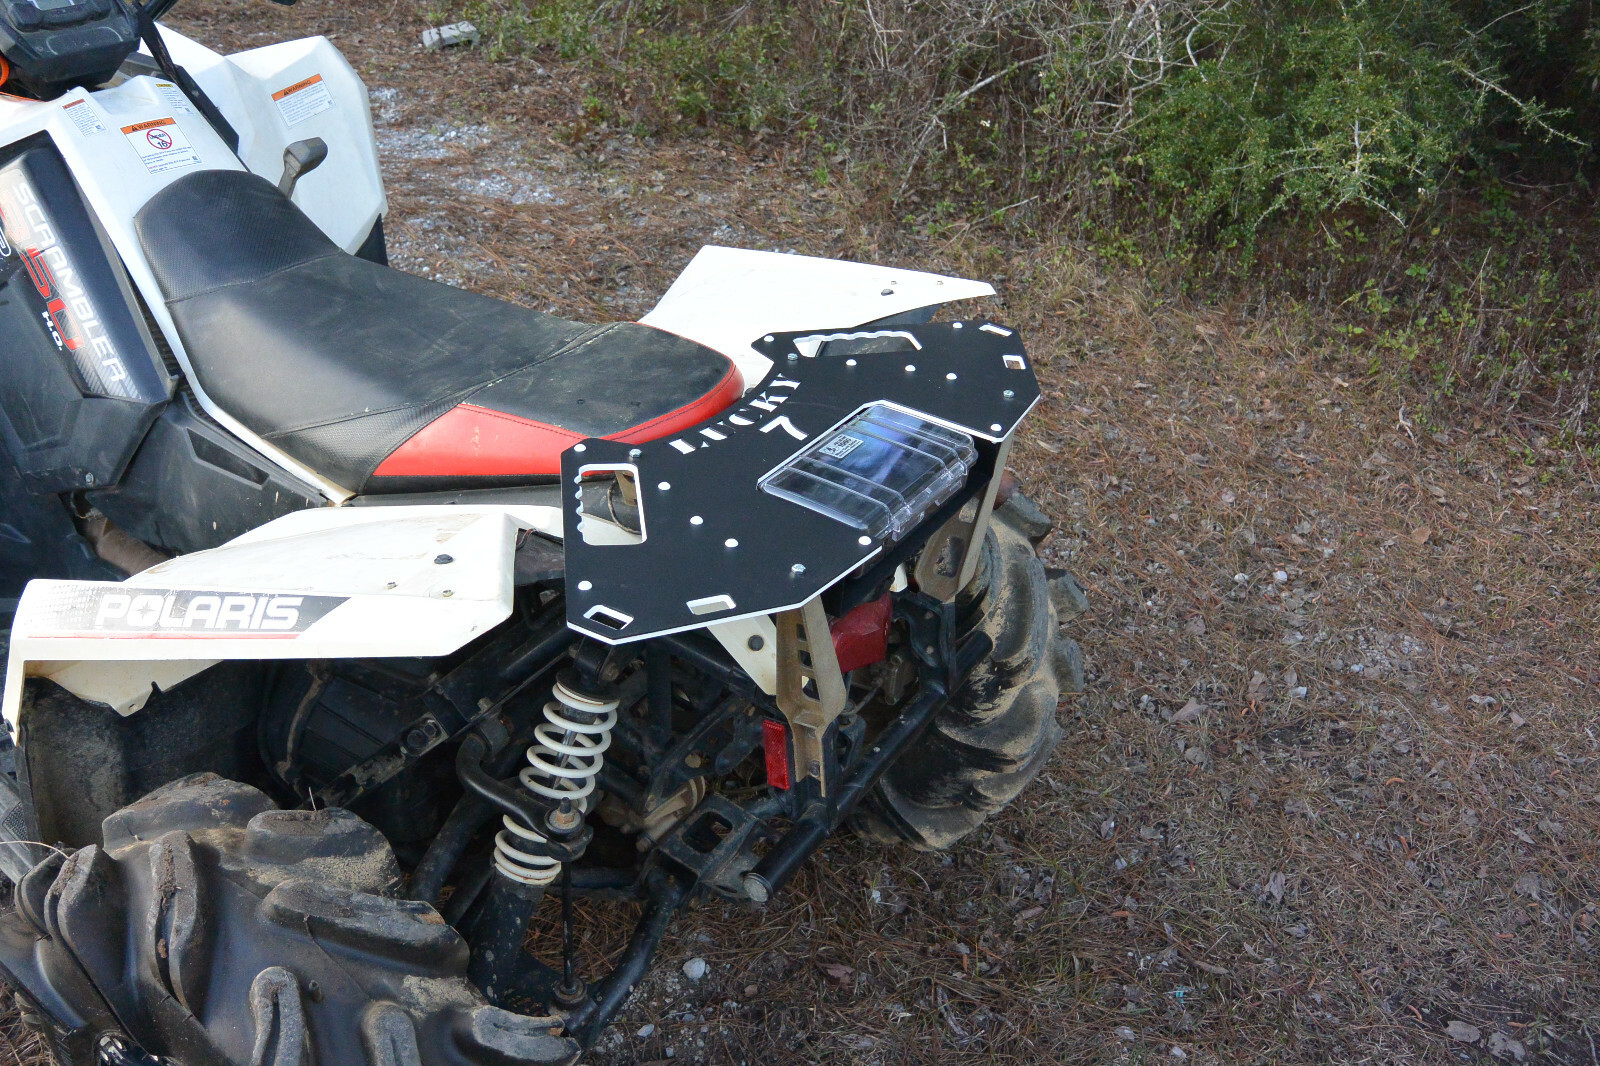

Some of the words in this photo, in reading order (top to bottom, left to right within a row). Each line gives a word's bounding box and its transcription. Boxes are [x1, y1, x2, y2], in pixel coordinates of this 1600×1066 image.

[287, 80, 312, 93] WARNING
[137, 119, 167, 130] WARNING
[13, 182, 126, 382] SCRAMBLER
[42, 311, 64, 351] H.O.
[669, 373, 801, 455] LUCKY
[759, 415, 809, 441] 7
[95, 594, 304, 630] POLARIS
